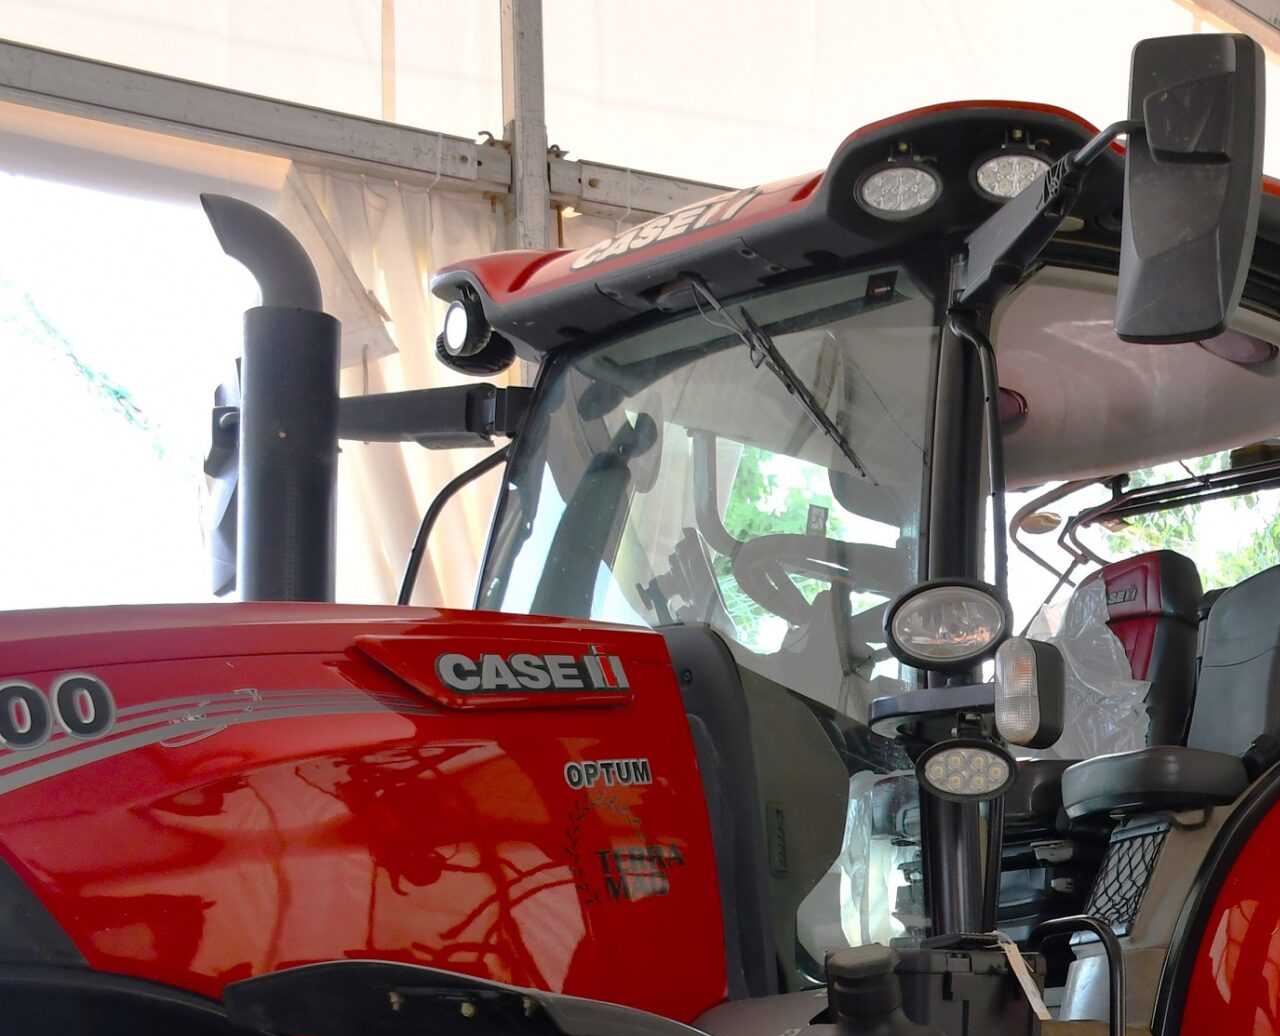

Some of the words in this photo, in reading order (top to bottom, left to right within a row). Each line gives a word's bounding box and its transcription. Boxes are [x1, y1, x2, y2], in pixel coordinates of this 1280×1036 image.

[436, 653, 584, 691] CASE
[563, 758, 653, 791] OPTUM
[595, 843, 686, 874] TERRA
